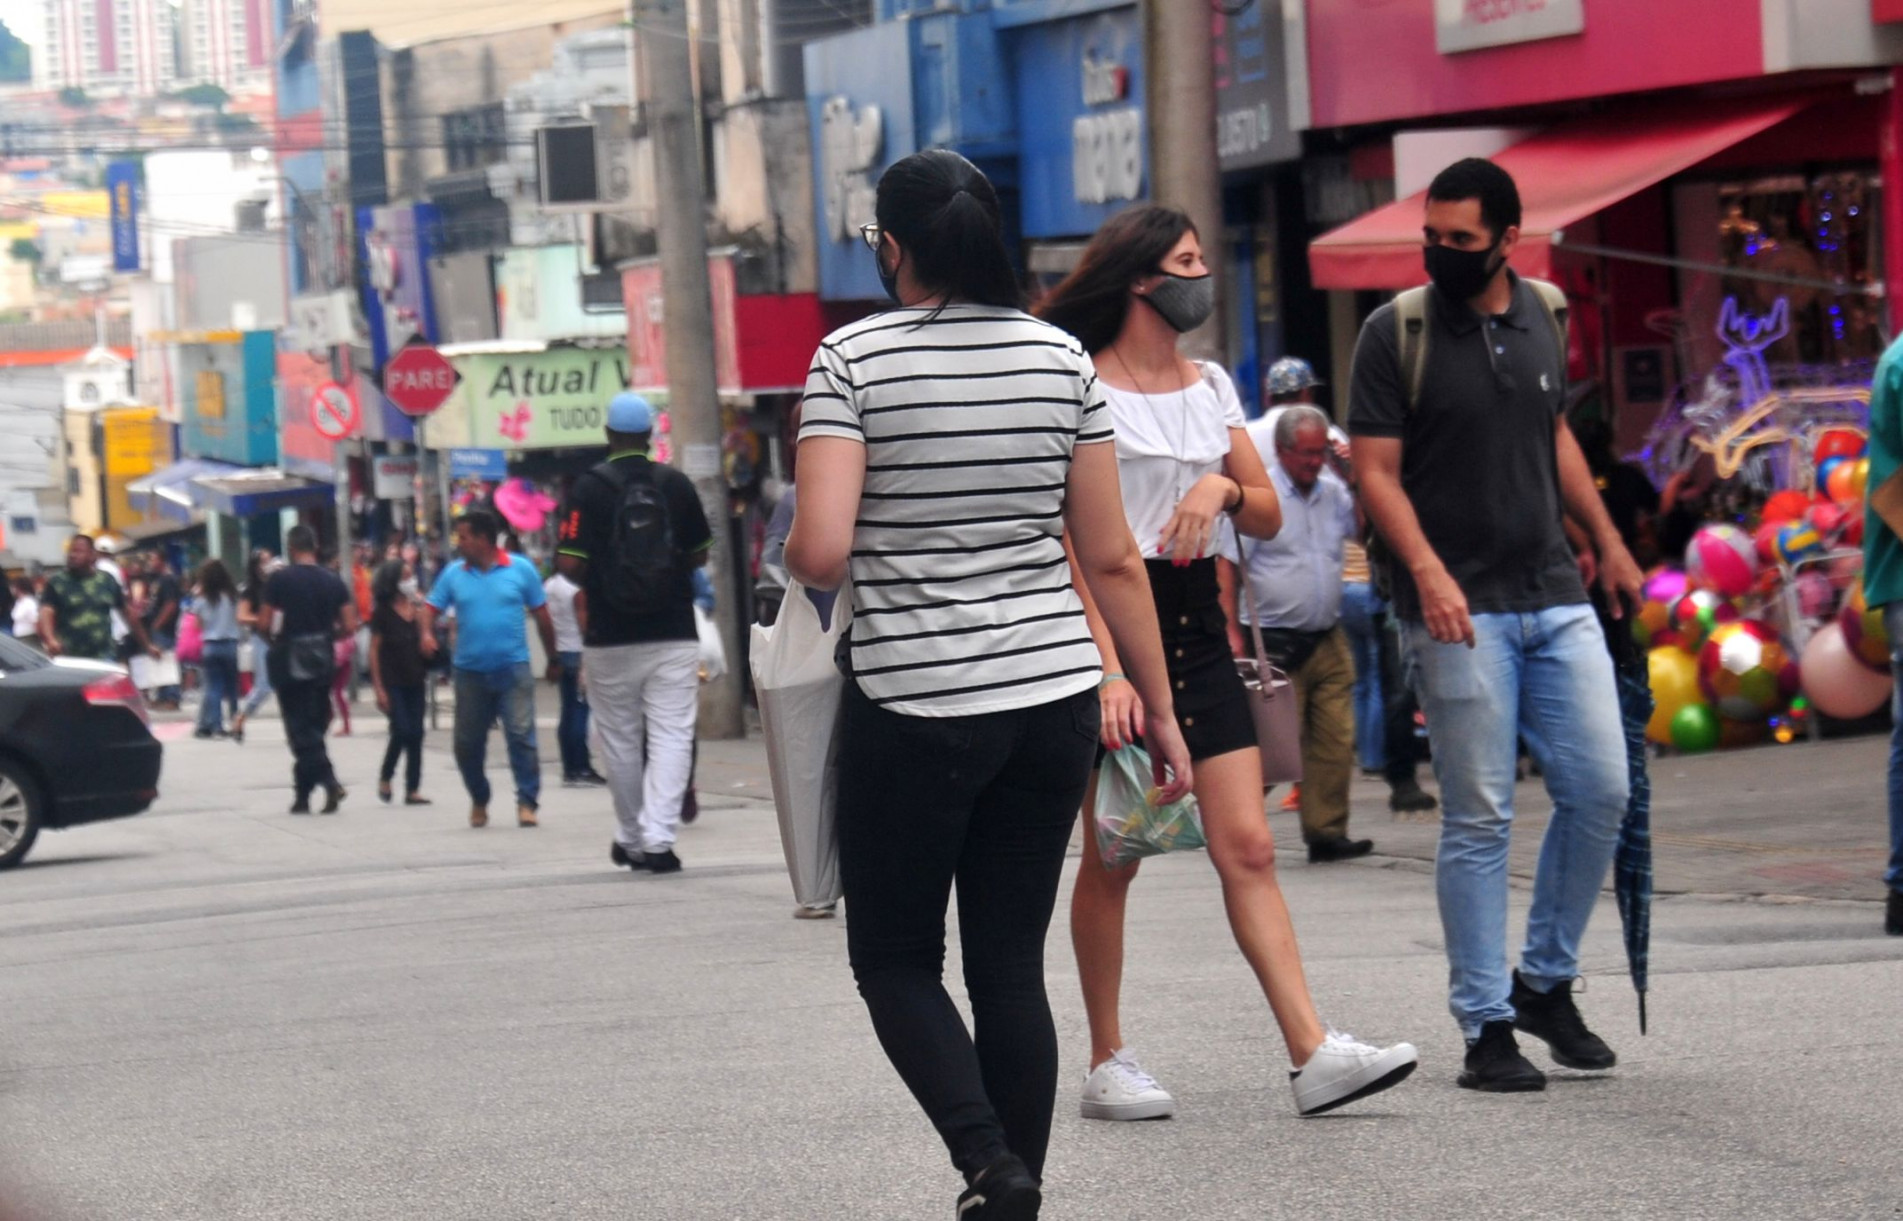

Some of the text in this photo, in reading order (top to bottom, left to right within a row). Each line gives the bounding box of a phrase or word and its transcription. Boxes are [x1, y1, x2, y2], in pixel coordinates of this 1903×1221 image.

[390, 369, 449, 390] PARE
[488, 359, 598, 398] Atual
[549, 407, 600, 431] TUDO
